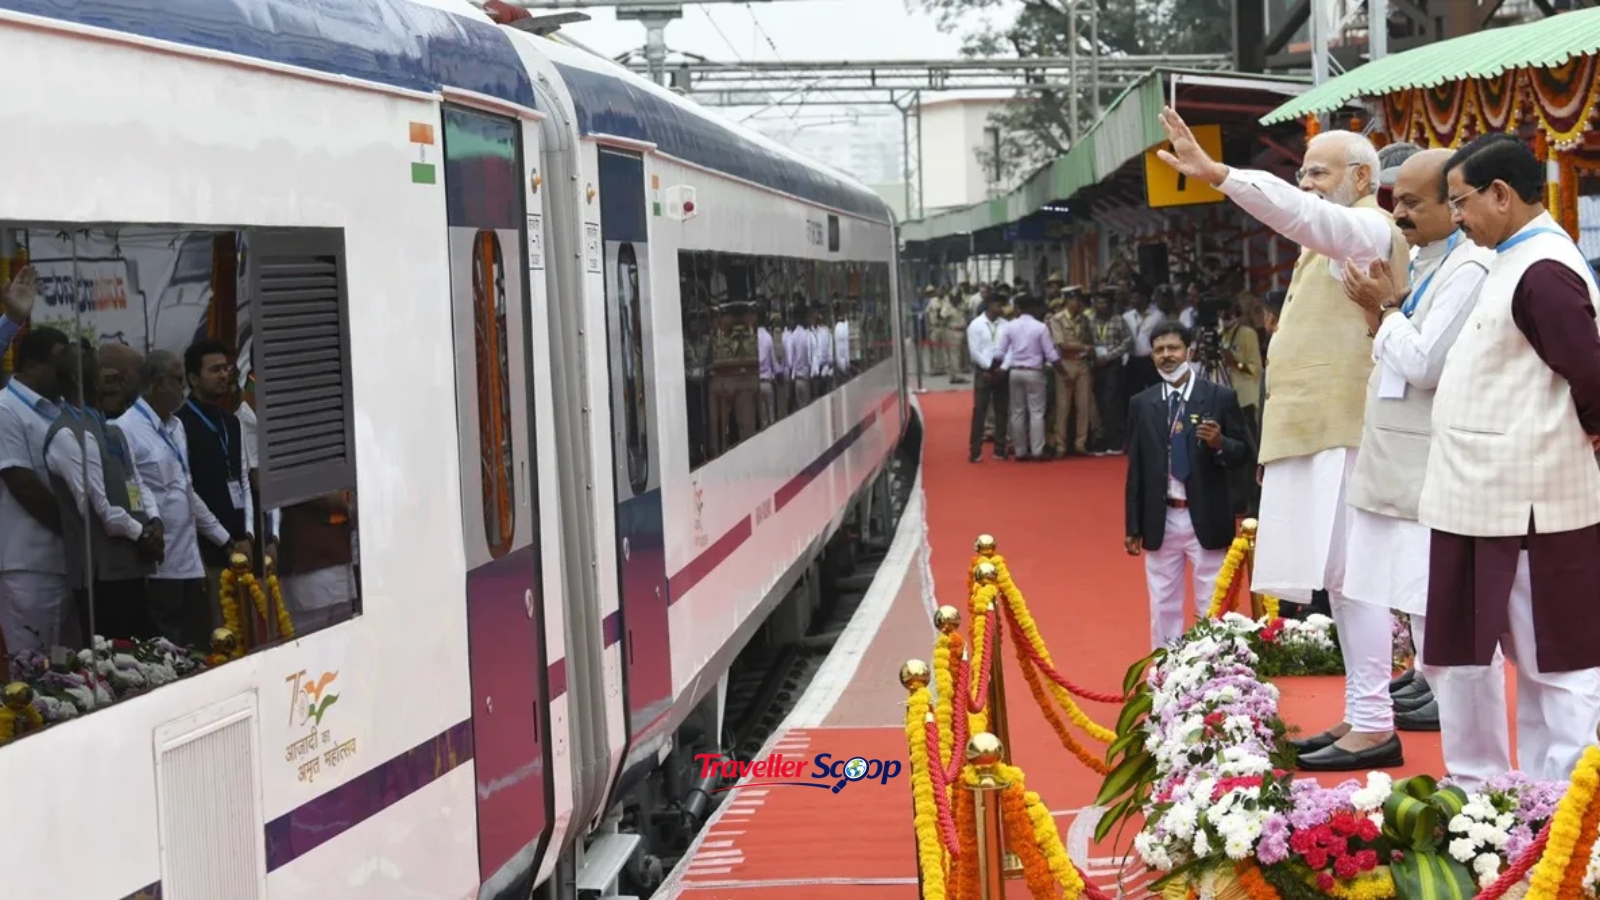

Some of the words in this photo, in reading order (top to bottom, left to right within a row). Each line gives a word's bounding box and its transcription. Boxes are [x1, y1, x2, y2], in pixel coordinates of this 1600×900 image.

[321, 730, 331, 743] का
[298, 757, 320, 782] अमृत
[324, 738, 357, 767] महोत्सव
